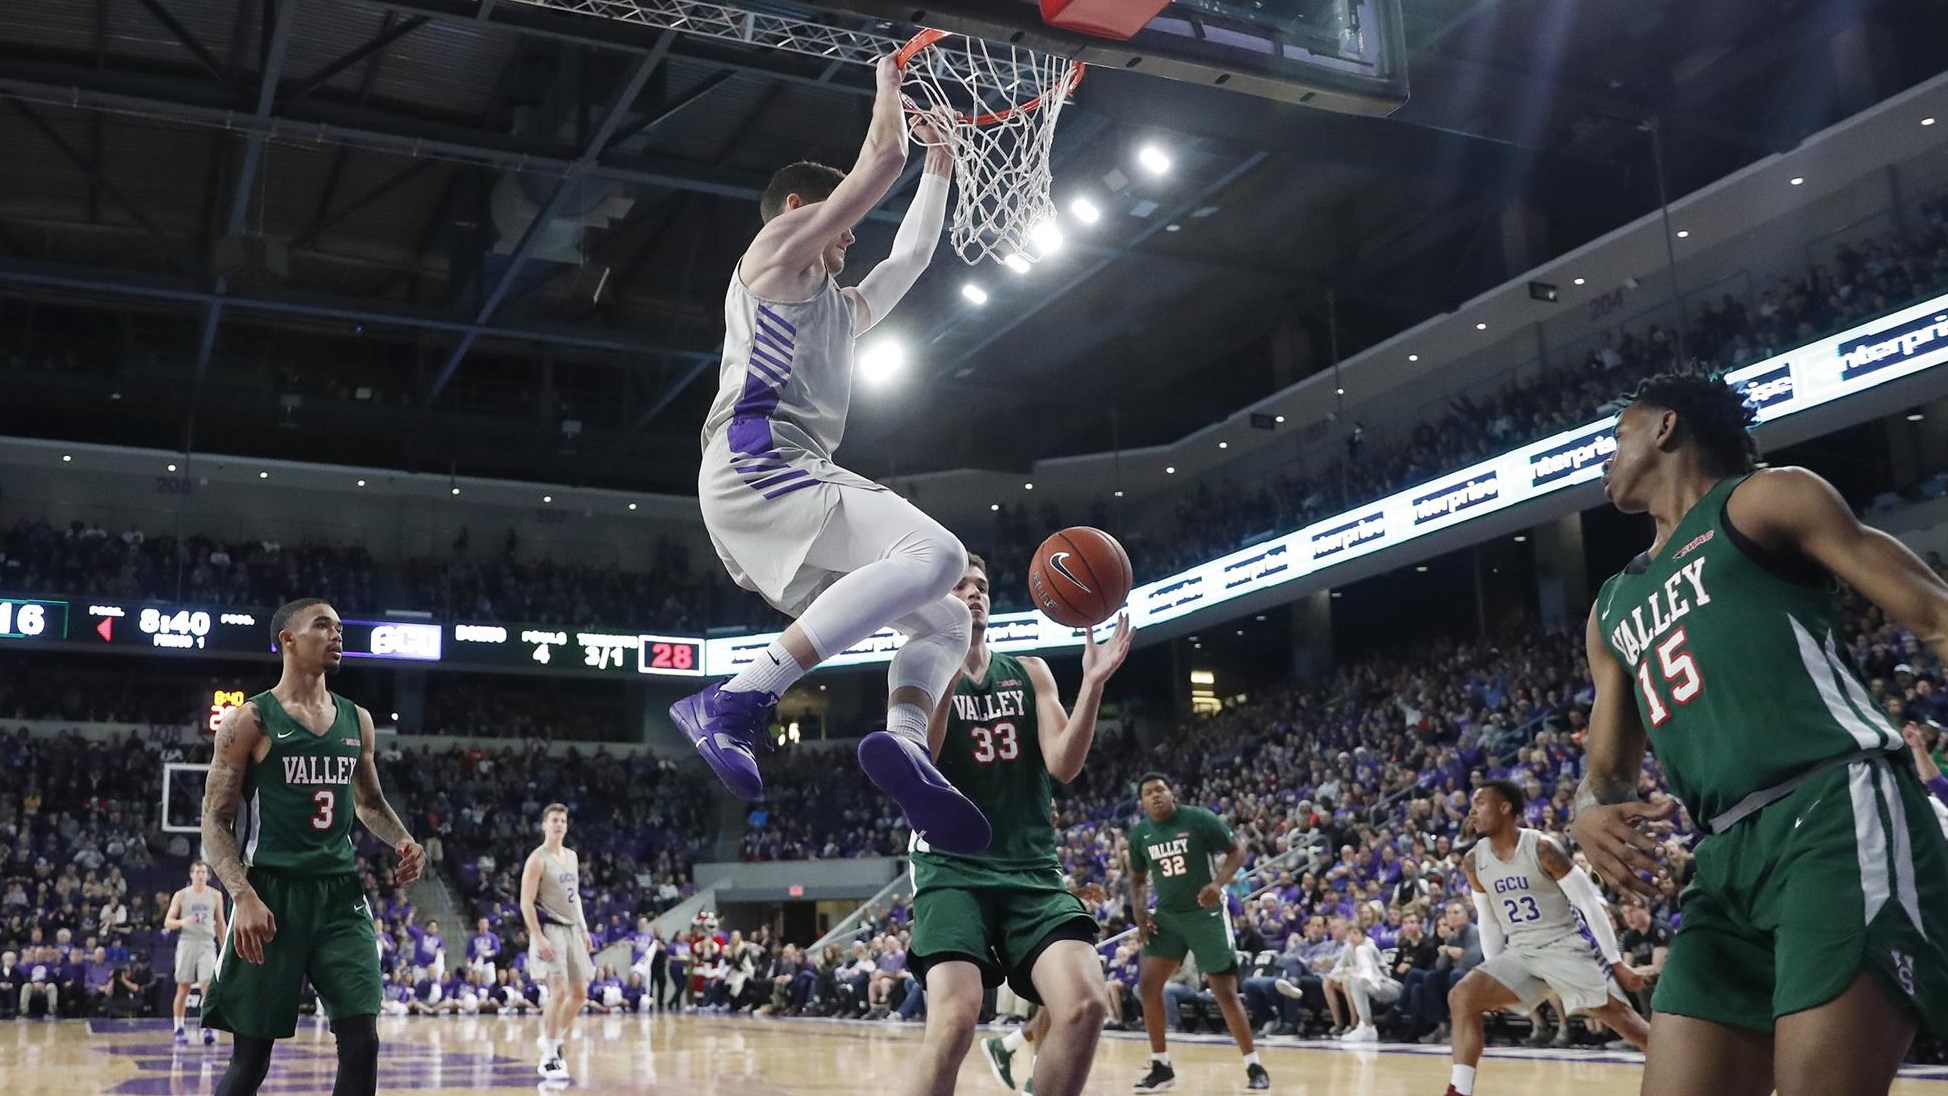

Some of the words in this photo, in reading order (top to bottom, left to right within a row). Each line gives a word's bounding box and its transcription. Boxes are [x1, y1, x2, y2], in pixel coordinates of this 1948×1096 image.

[0, 602, 45, 636] 16
[139, 608, 211, 637] 8:40
[1611, 556, 1711, 666] VALLEY
[196, 636, 205, 649] 1
[532, 643, 550, 664] 4
[584, 645, 624, 670] 3/1
[651, 643, 693, 669] 28
[1638, 626, 1703, 728] 15
[209, 705, 237, 731] 2
[952, 690, 1025, 721] VALLEY
[970, 721, 1020, 763] 33
[311, 789, 336, 831] 3
[1147, 838, 1188, 860] VALLEY
[1159, 855, 1187, 878] 32
[567, 887, 575, 903] 2
[1494, 876, 1529, 894] GCU
[1503, 895, 1541, 924] 23
